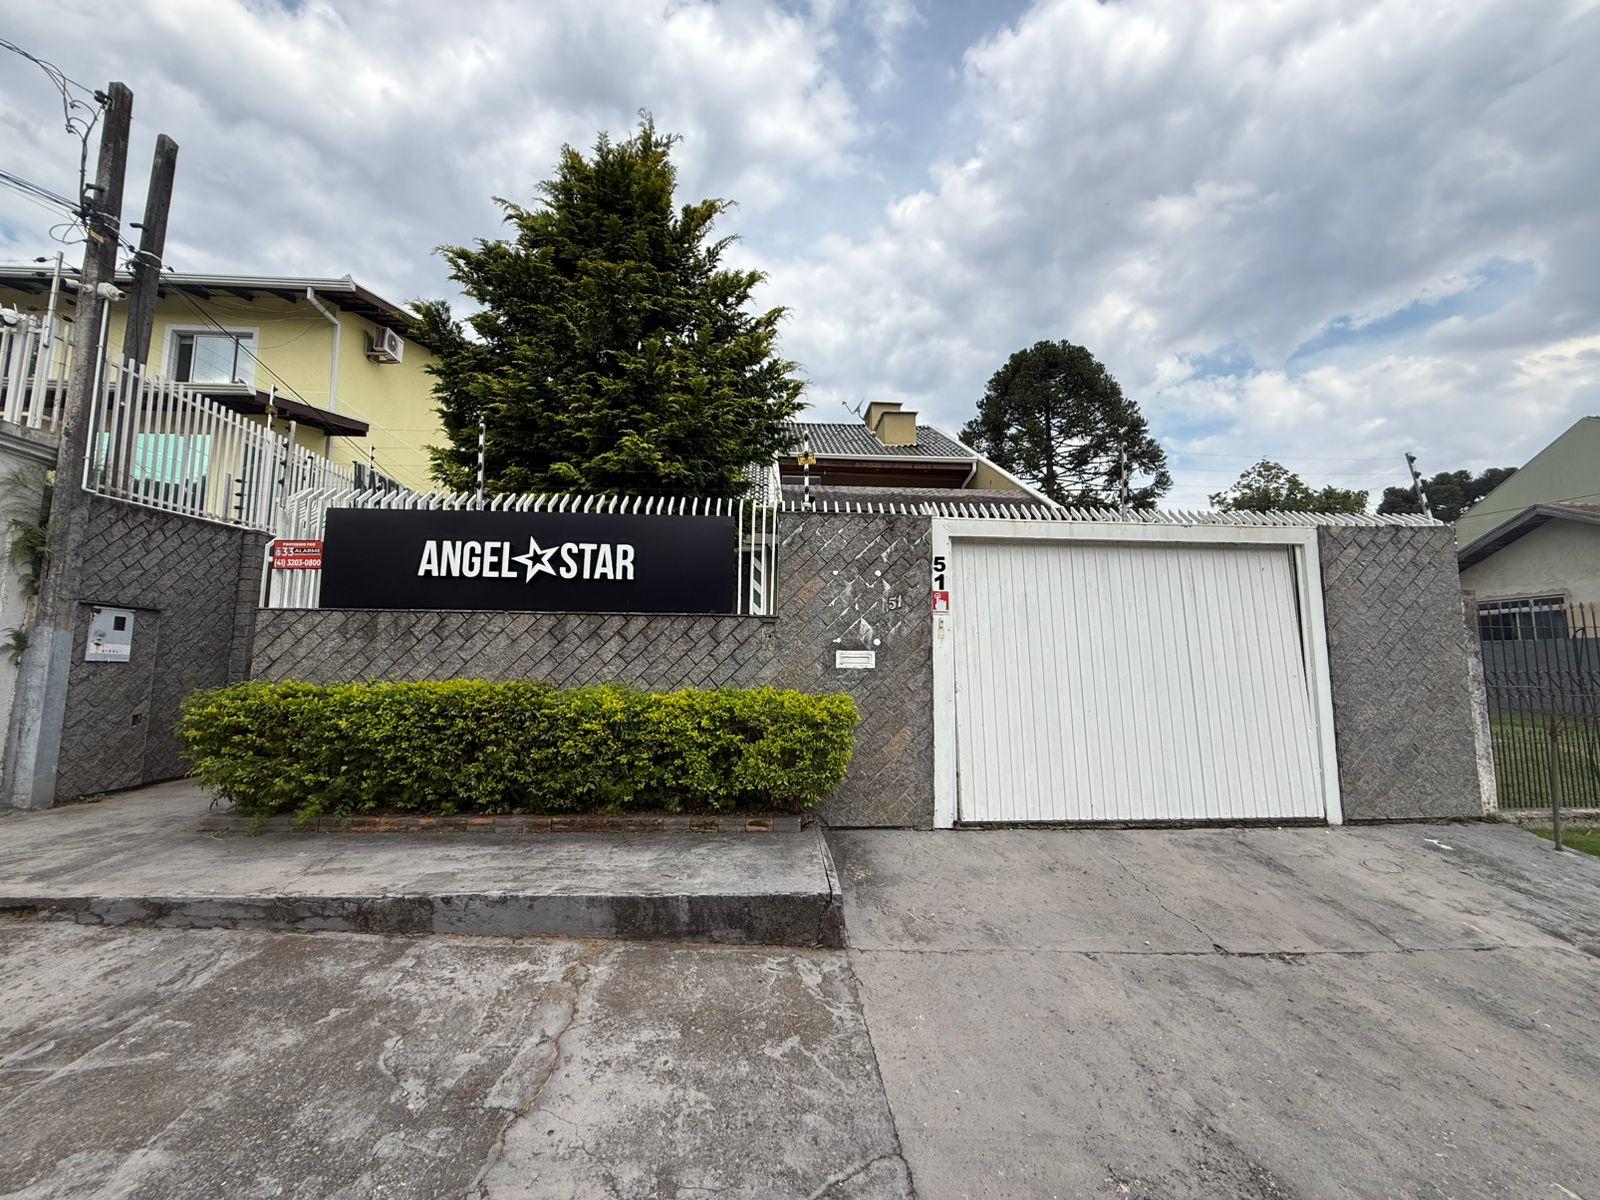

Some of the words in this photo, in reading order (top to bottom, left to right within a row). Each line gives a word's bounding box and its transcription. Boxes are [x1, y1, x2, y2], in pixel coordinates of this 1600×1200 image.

[281, 547, 294, 557] 33
[274, 558, 286, 568] (41)
[287, 559, 322, 567] 3203-0800
[417, 540, 518, 578] ANGEL
[559, 542, 635, 580] STAR
[888, 594, 902, 610] 51
